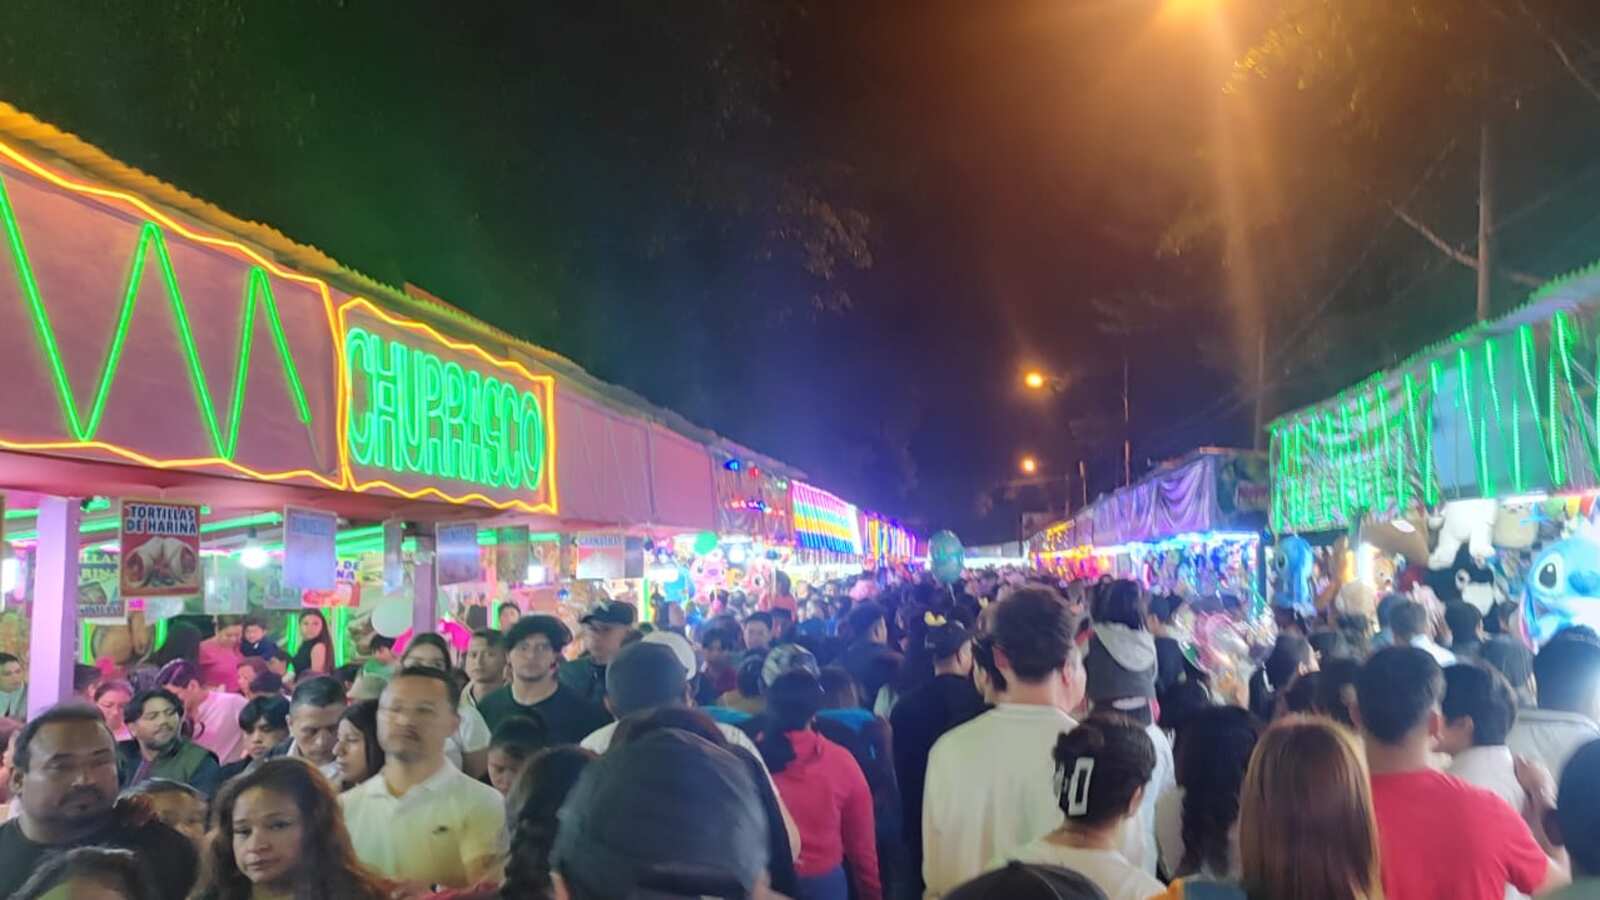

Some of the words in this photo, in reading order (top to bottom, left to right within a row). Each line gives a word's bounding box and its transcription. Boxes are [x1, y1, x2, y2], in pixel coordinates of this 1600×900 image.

[346, 326, 544, 490] CHURRASCO
[129, 505, 195, 521] TORTILLAS
[126, 518, 144, 533] DE
[148, 519, 197, 536] HARINA
